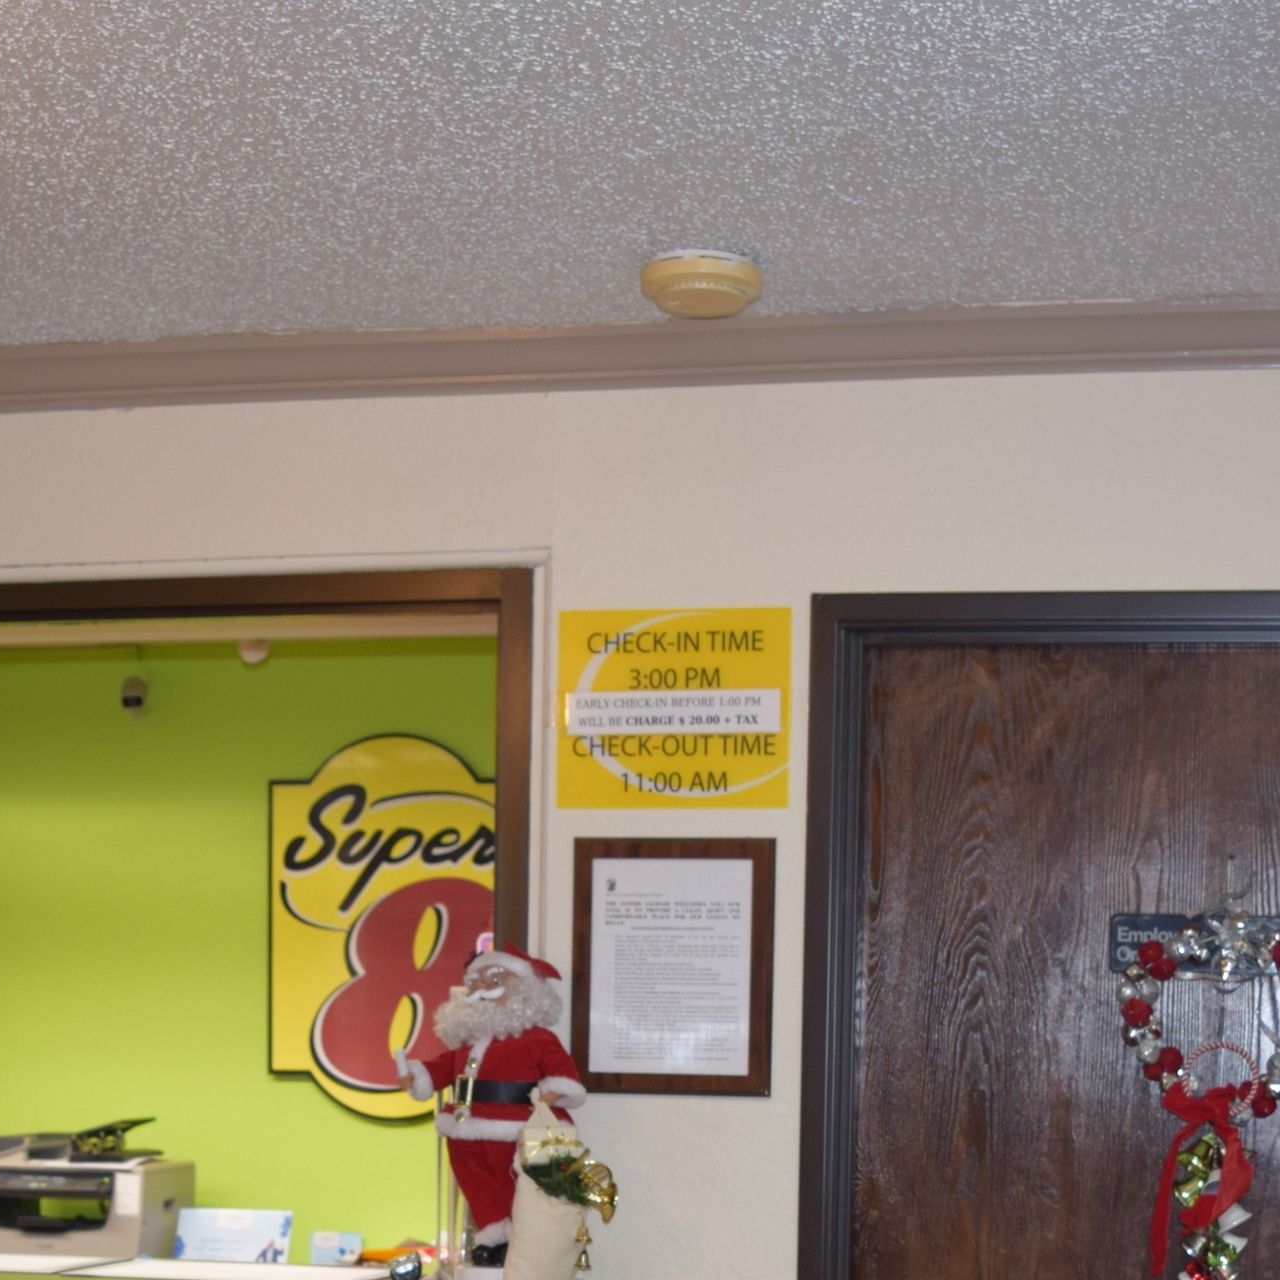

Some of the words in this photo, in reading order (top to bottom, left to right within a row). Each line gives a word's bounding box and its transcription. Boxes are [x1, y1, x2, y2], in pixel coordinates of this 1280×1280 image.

[587, 632, 700, 654] CHECK-IN
[707, 630, 764, 651] TIME
[629, 668, 677, 689] 3:00
[685, 667, 721, 688] PM
[576, 698, 610, 710] EARLY
[613, 697, 667, 709] CHECK-IN
[671, 697, 715, 707] BEFORE
[719, 696, 741, 707] 1:00
[744, 696, 761, 706] PM
[578, 717, 607, 728] WILL
[608, 717, 623, 727] BE
[626, 716, 674, 727] CHARGE
[689, 715, 720, 726] 20.00
[735, 715, 758, 725] TAX
[572, 735, 709, 758] CHECK-OUT
[721, 734, 776, 756] TIME
[622, 772, 681, 793] 11:00
[690, 771, 728, 792] AM
[284, 783, 495, 914] Super
[311, 877, 494, 1091] 8
